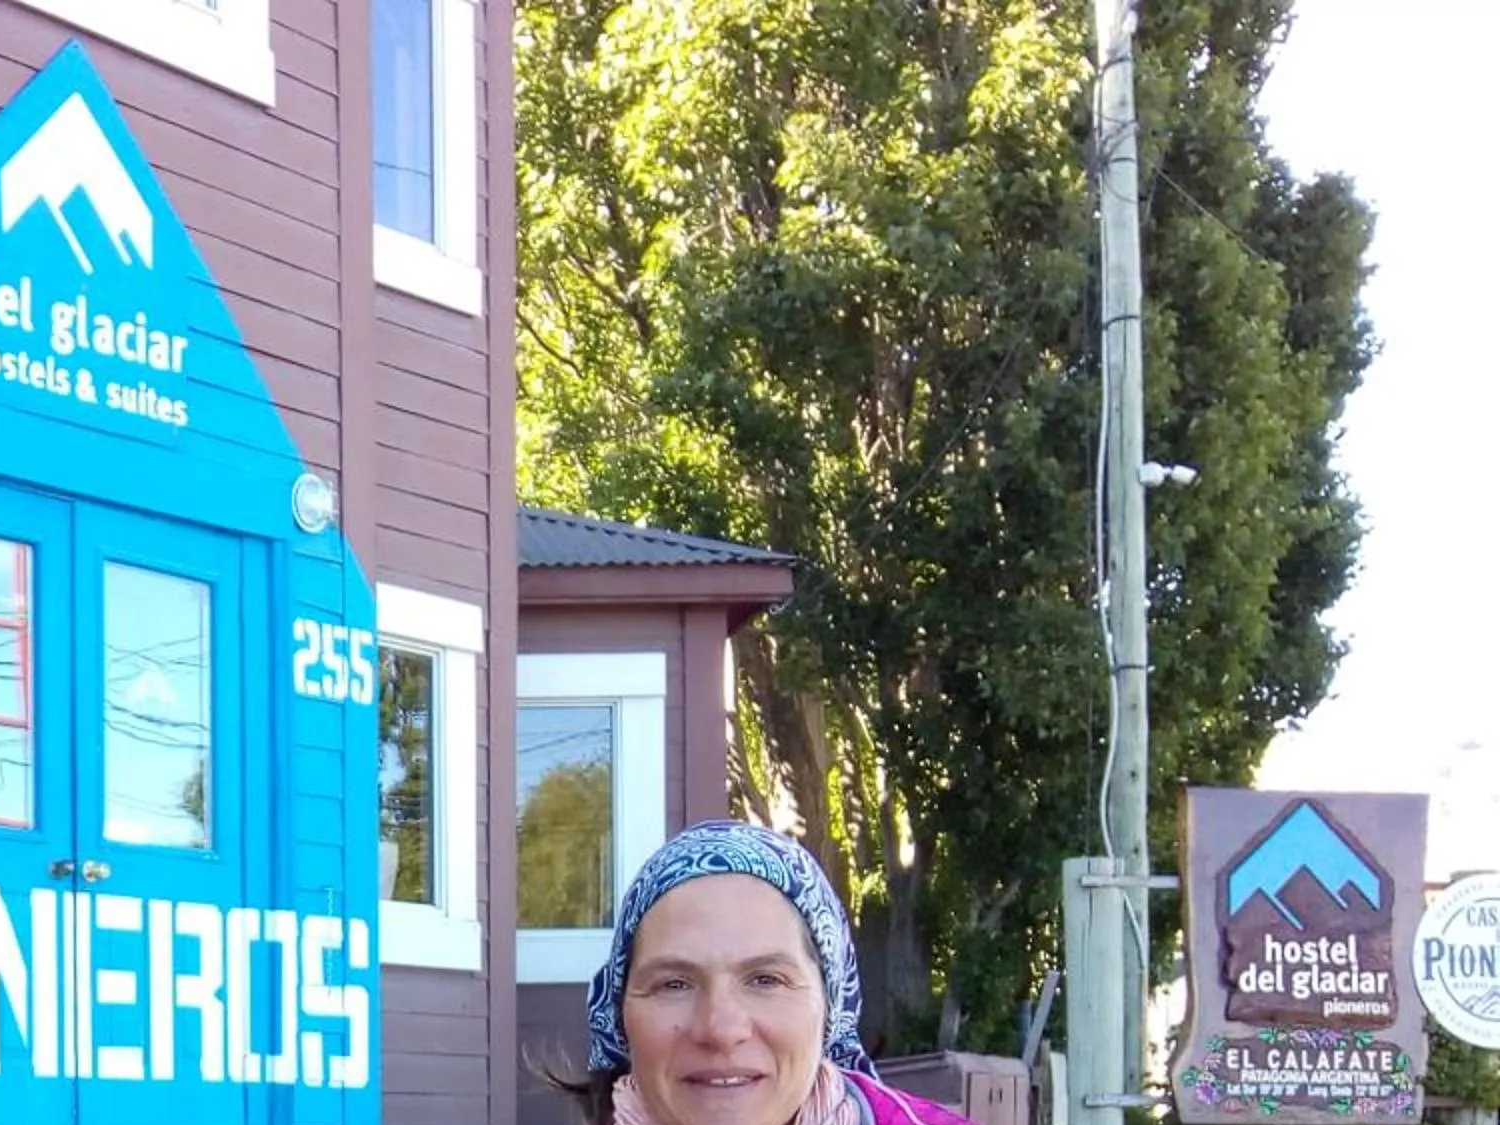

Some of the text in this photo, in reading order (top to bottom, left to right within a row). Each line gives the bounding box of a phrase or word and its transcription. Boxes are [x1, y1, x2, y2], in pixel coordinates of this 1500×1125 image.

[51, 294, 188, 373] glaciar
[75, 367, 99, 403] &
[106, 381, 188, 426] suites
[292, 616, 373, 704] 255
[1264, 933, 1357, 965] hostel
[1238, 962, 1389, 999] del glaciar
[1323, 997, 1390, 1018] pioneros
[1226, 1048, 1393, 1071] EL CALAFATE
[1240, 1069, 1380, 1085] PATAGONIA ARGENTINA
